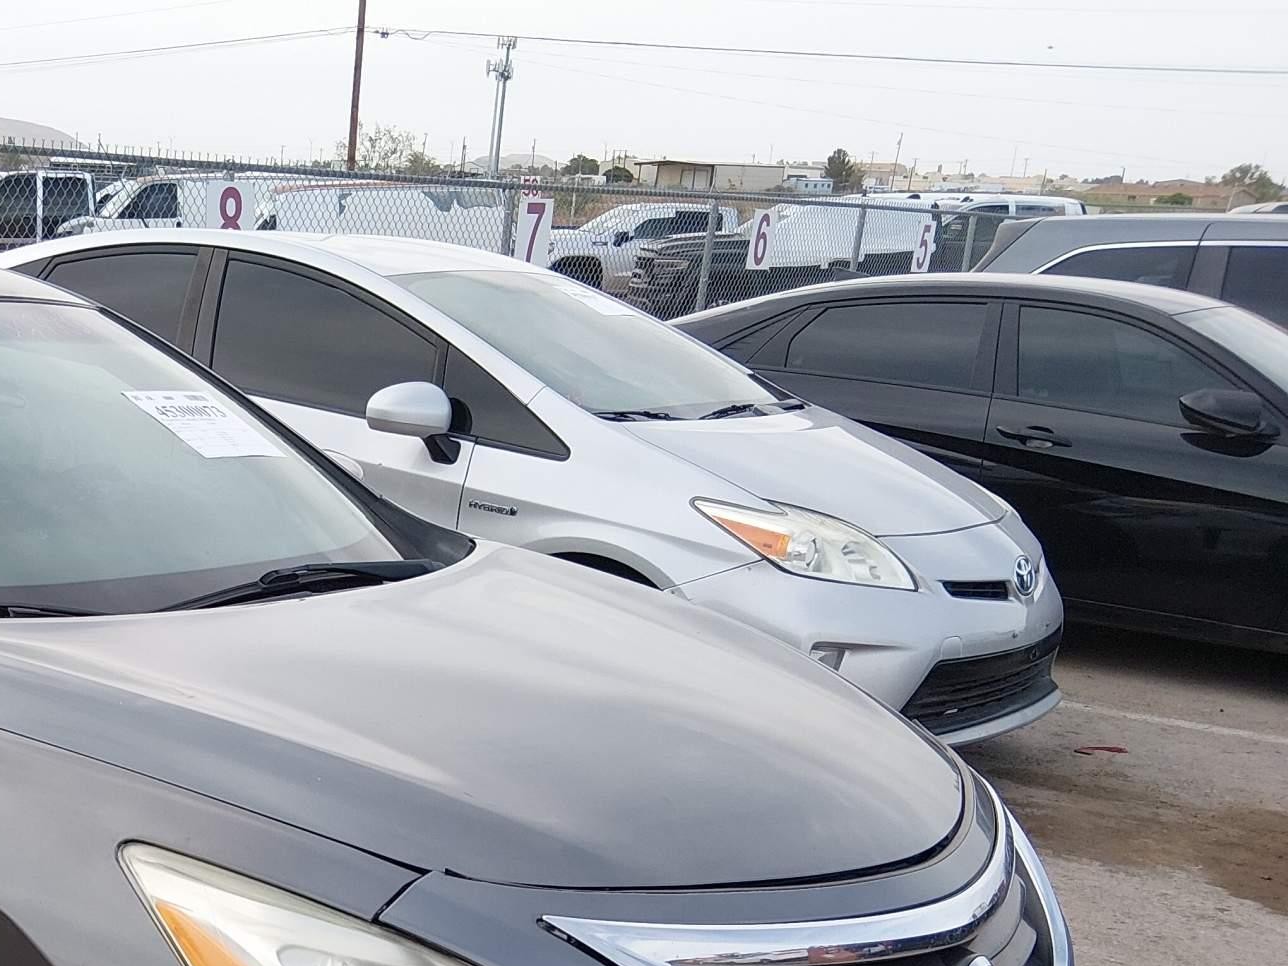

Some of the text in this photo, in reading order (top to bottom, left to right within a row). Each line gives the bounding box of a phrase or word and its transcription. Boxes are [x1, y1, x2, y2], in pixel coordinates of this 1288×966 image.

[220, 186, 243, 230] 8
[526, 202, 546, 263] 7
[753, 213, 771, 267] 6
[916, 224, 933, 270] 5
